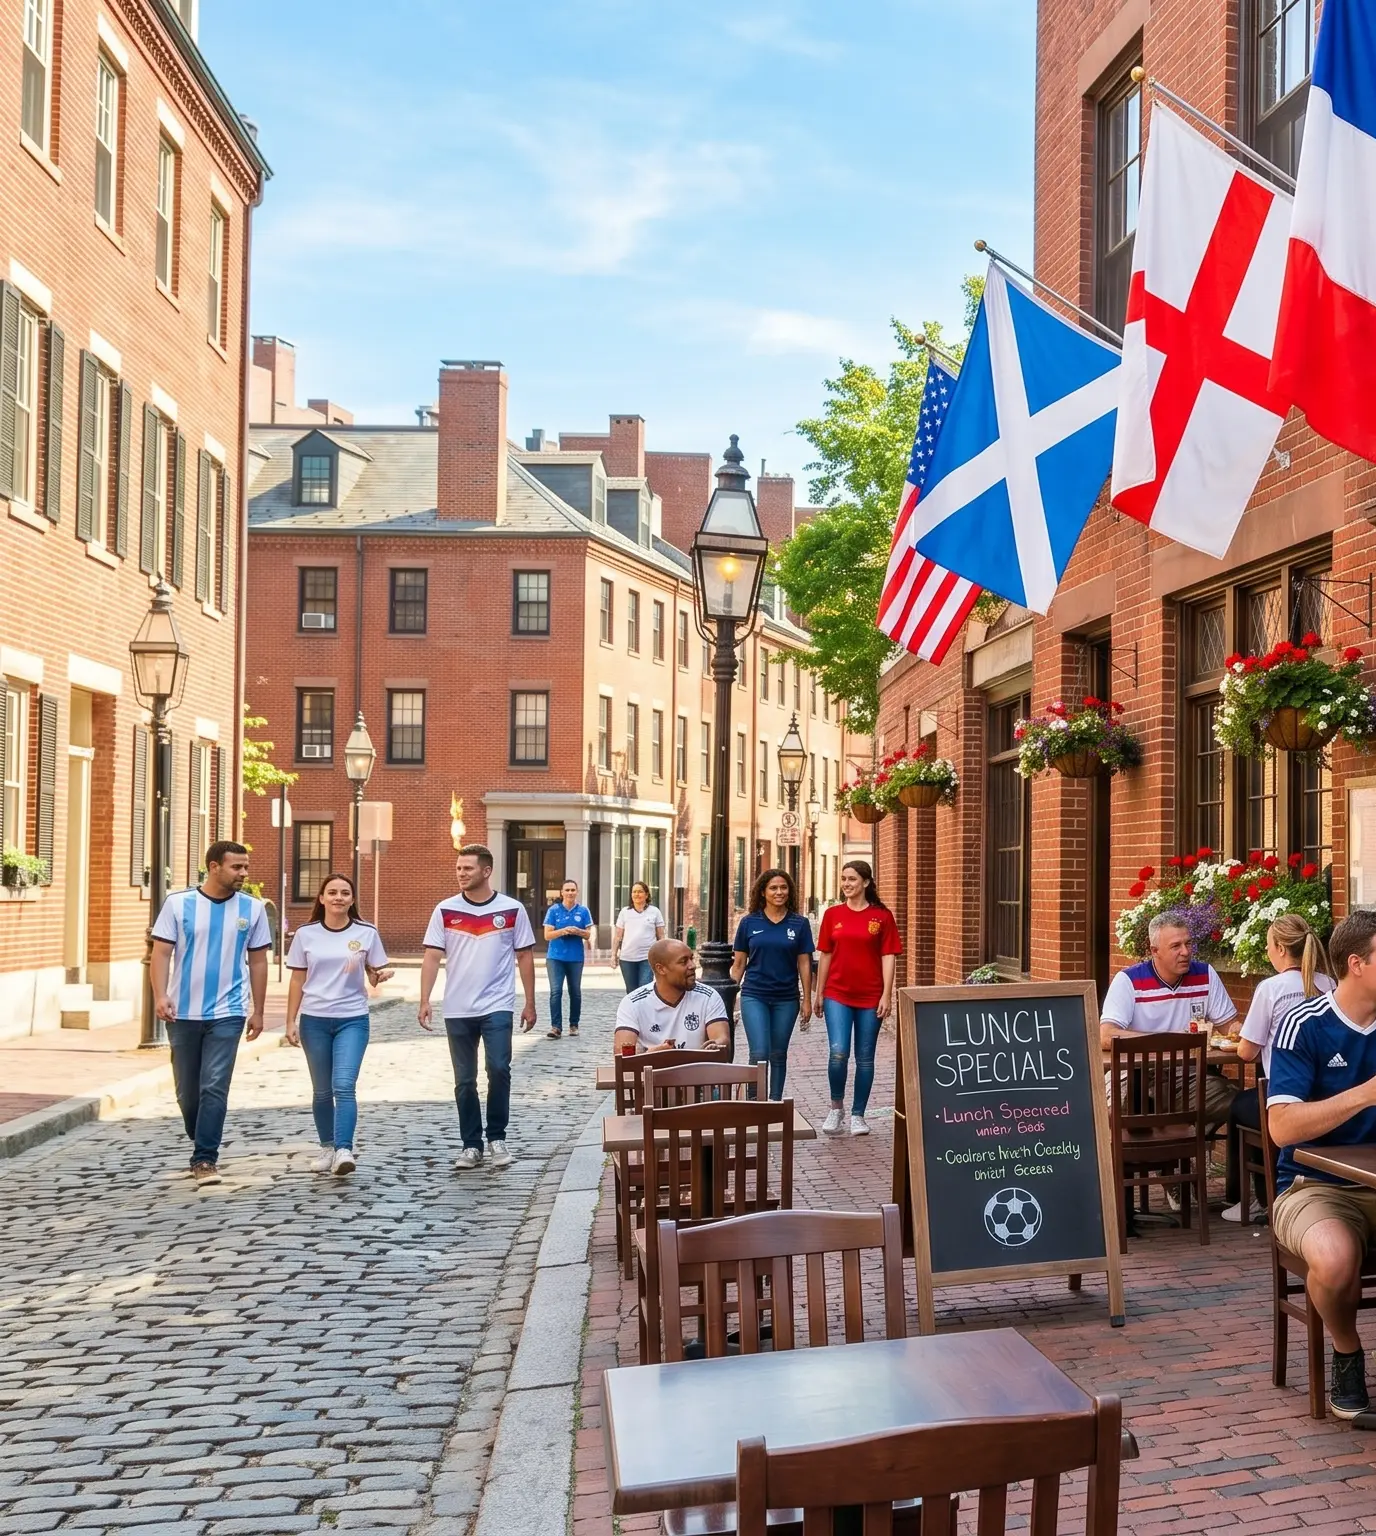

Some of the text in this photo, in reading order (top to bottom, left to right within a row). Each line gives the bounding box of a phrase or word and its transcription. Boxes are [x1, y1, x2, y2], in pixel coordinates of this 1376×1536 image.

[944, 1009, 1055, 1047] LUNCH
[935, 1048, 1074, 1087] SPECIALS
[943, 1106, 994, 1124] Lunch
